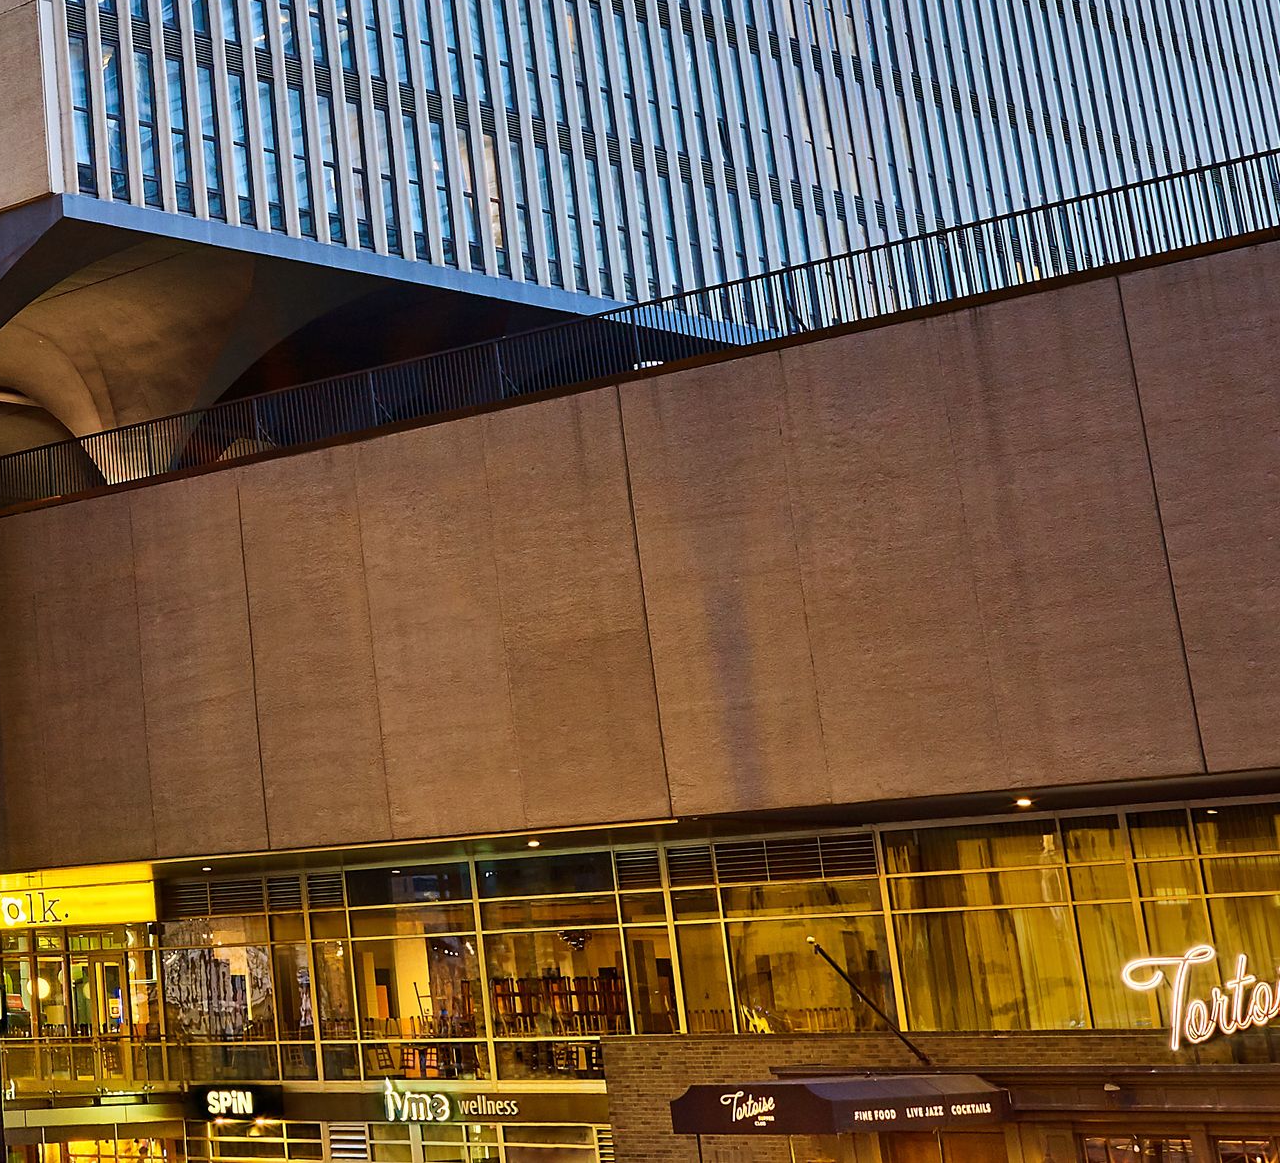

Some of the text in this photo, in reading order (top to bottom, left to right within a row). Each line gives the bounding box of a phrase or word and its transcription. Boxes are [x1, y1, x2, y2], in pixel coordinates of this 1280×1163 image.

[1122, 945, 1280, 1051] Torto
[458, 1095, 519, 1116] wellness
[720, 1090, 776, 1122] Tortoise
[905, 1105, 944, 1119] LIVE JAZZ
[951, 1102, 992, 1116] COCKTAILS
[854, 1109, 897, 1121] FINE FOOD
